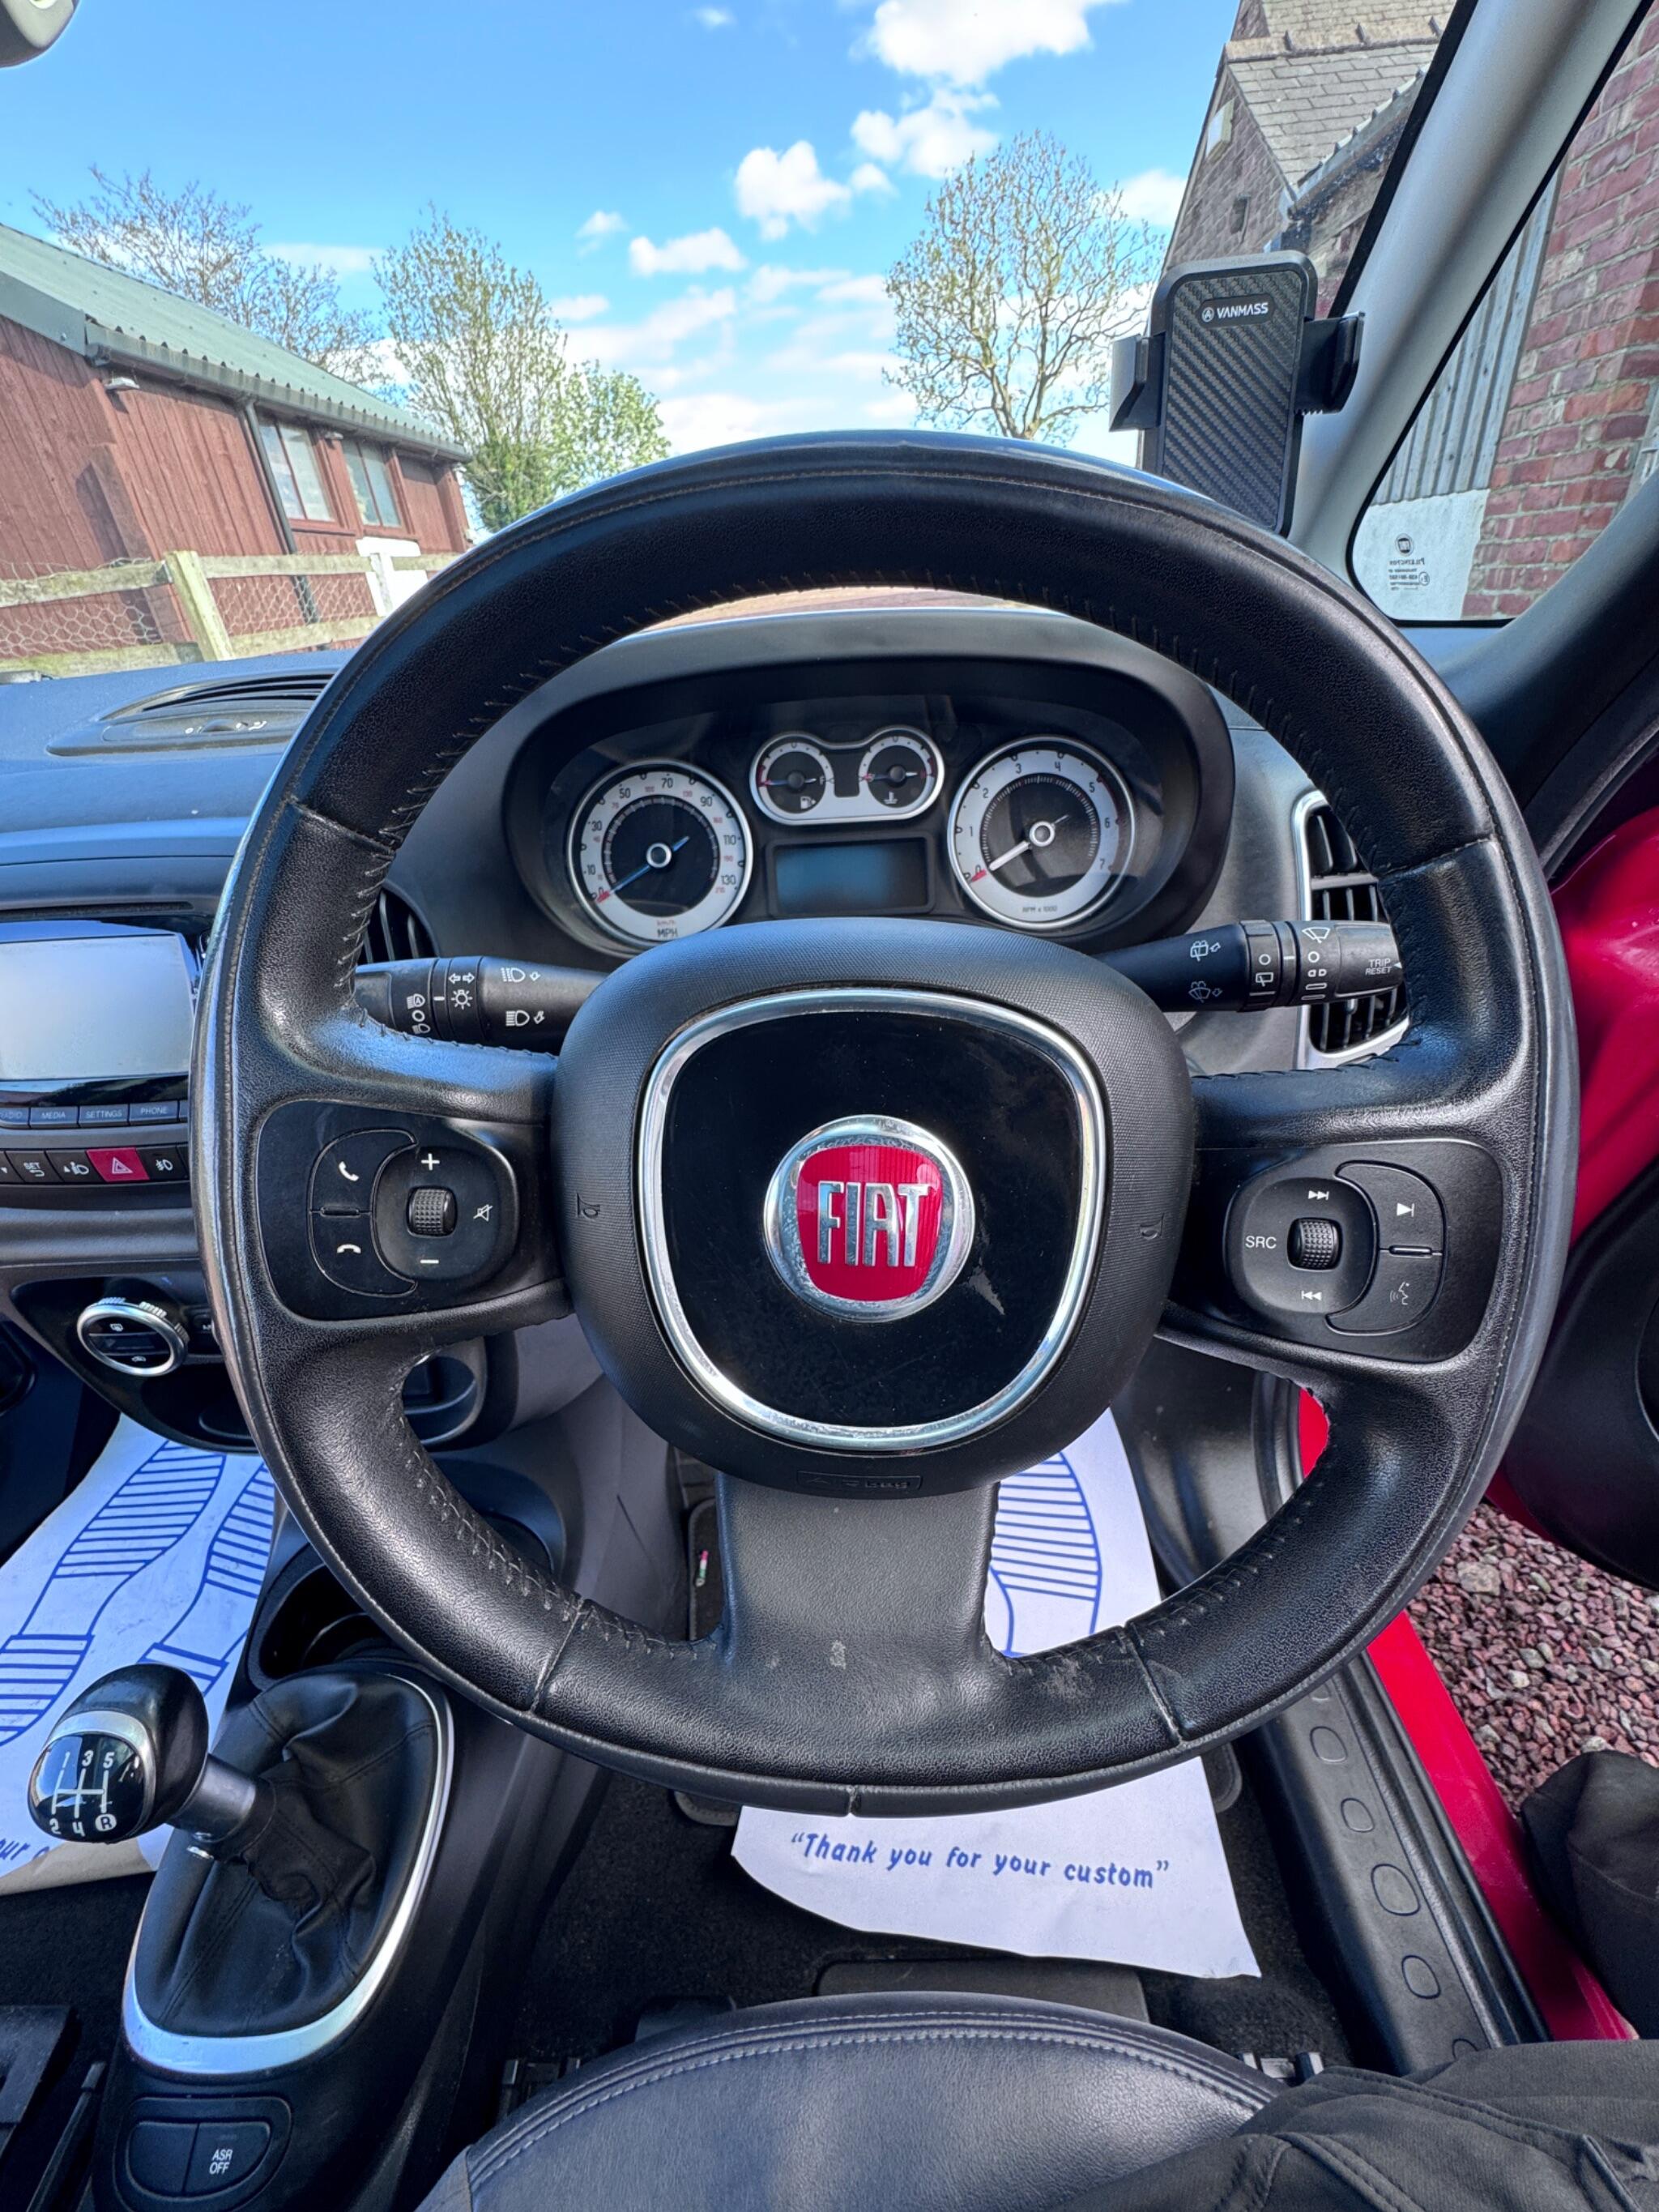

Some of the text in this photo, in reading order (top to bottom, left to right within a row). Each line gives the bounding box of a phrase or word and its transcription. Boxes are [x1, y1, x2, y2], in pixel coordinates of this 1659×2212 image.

[1217, 302, 1269, 318] VANMASS
[1016, 763, 1021, 774] 3
[1055, 762, 1061, 771] 4
[661, 778, 673, 788] 70
[1089, 782, 1095, 793] 5
[619, 788, 631, 798] 50
[983, 788, 988, 799] 2
[700, 796, 713, 807] 90
[591, 821, 603, 831] 30
[1104, 818, 1111, 828] 6
[970, 826, 974, 836] 1
[723, 835, 736, 845] 110
[1100, 859, 1106, 869] 7
[587, 865, 596, 875] 10
[721, 875, 736, 886] 130
[657, 928, 678, 937] MPH
[1368, 959, 1391, 967] TRIP
[1365, 967, 1392, 976] RESET
[86, 1109, 122, 1119] SETTINGS
[140, 1106, 168, 1115] PHONE
[23, 1162, 41, 1170] SET
[817, 1180, 930, 1267] FIAT
[1245, 1236, 1277, 1249] SRC
[62, 1752, 70, 1768] 1
[82, 1749, 94, 1766] 3
[103, 1752, 114, 1768] 5
[49, 1818, 62, 1834] 2
[72, 1821, 85, 1837] 4
[887, 1848, 932, 1871] you
[946, 1847, 982, 1868] for
[992, 1854, 1052, 1876] your
[211, 2149, 233, 2161] ASR
[209, 2162, 230, 2174] OFF
